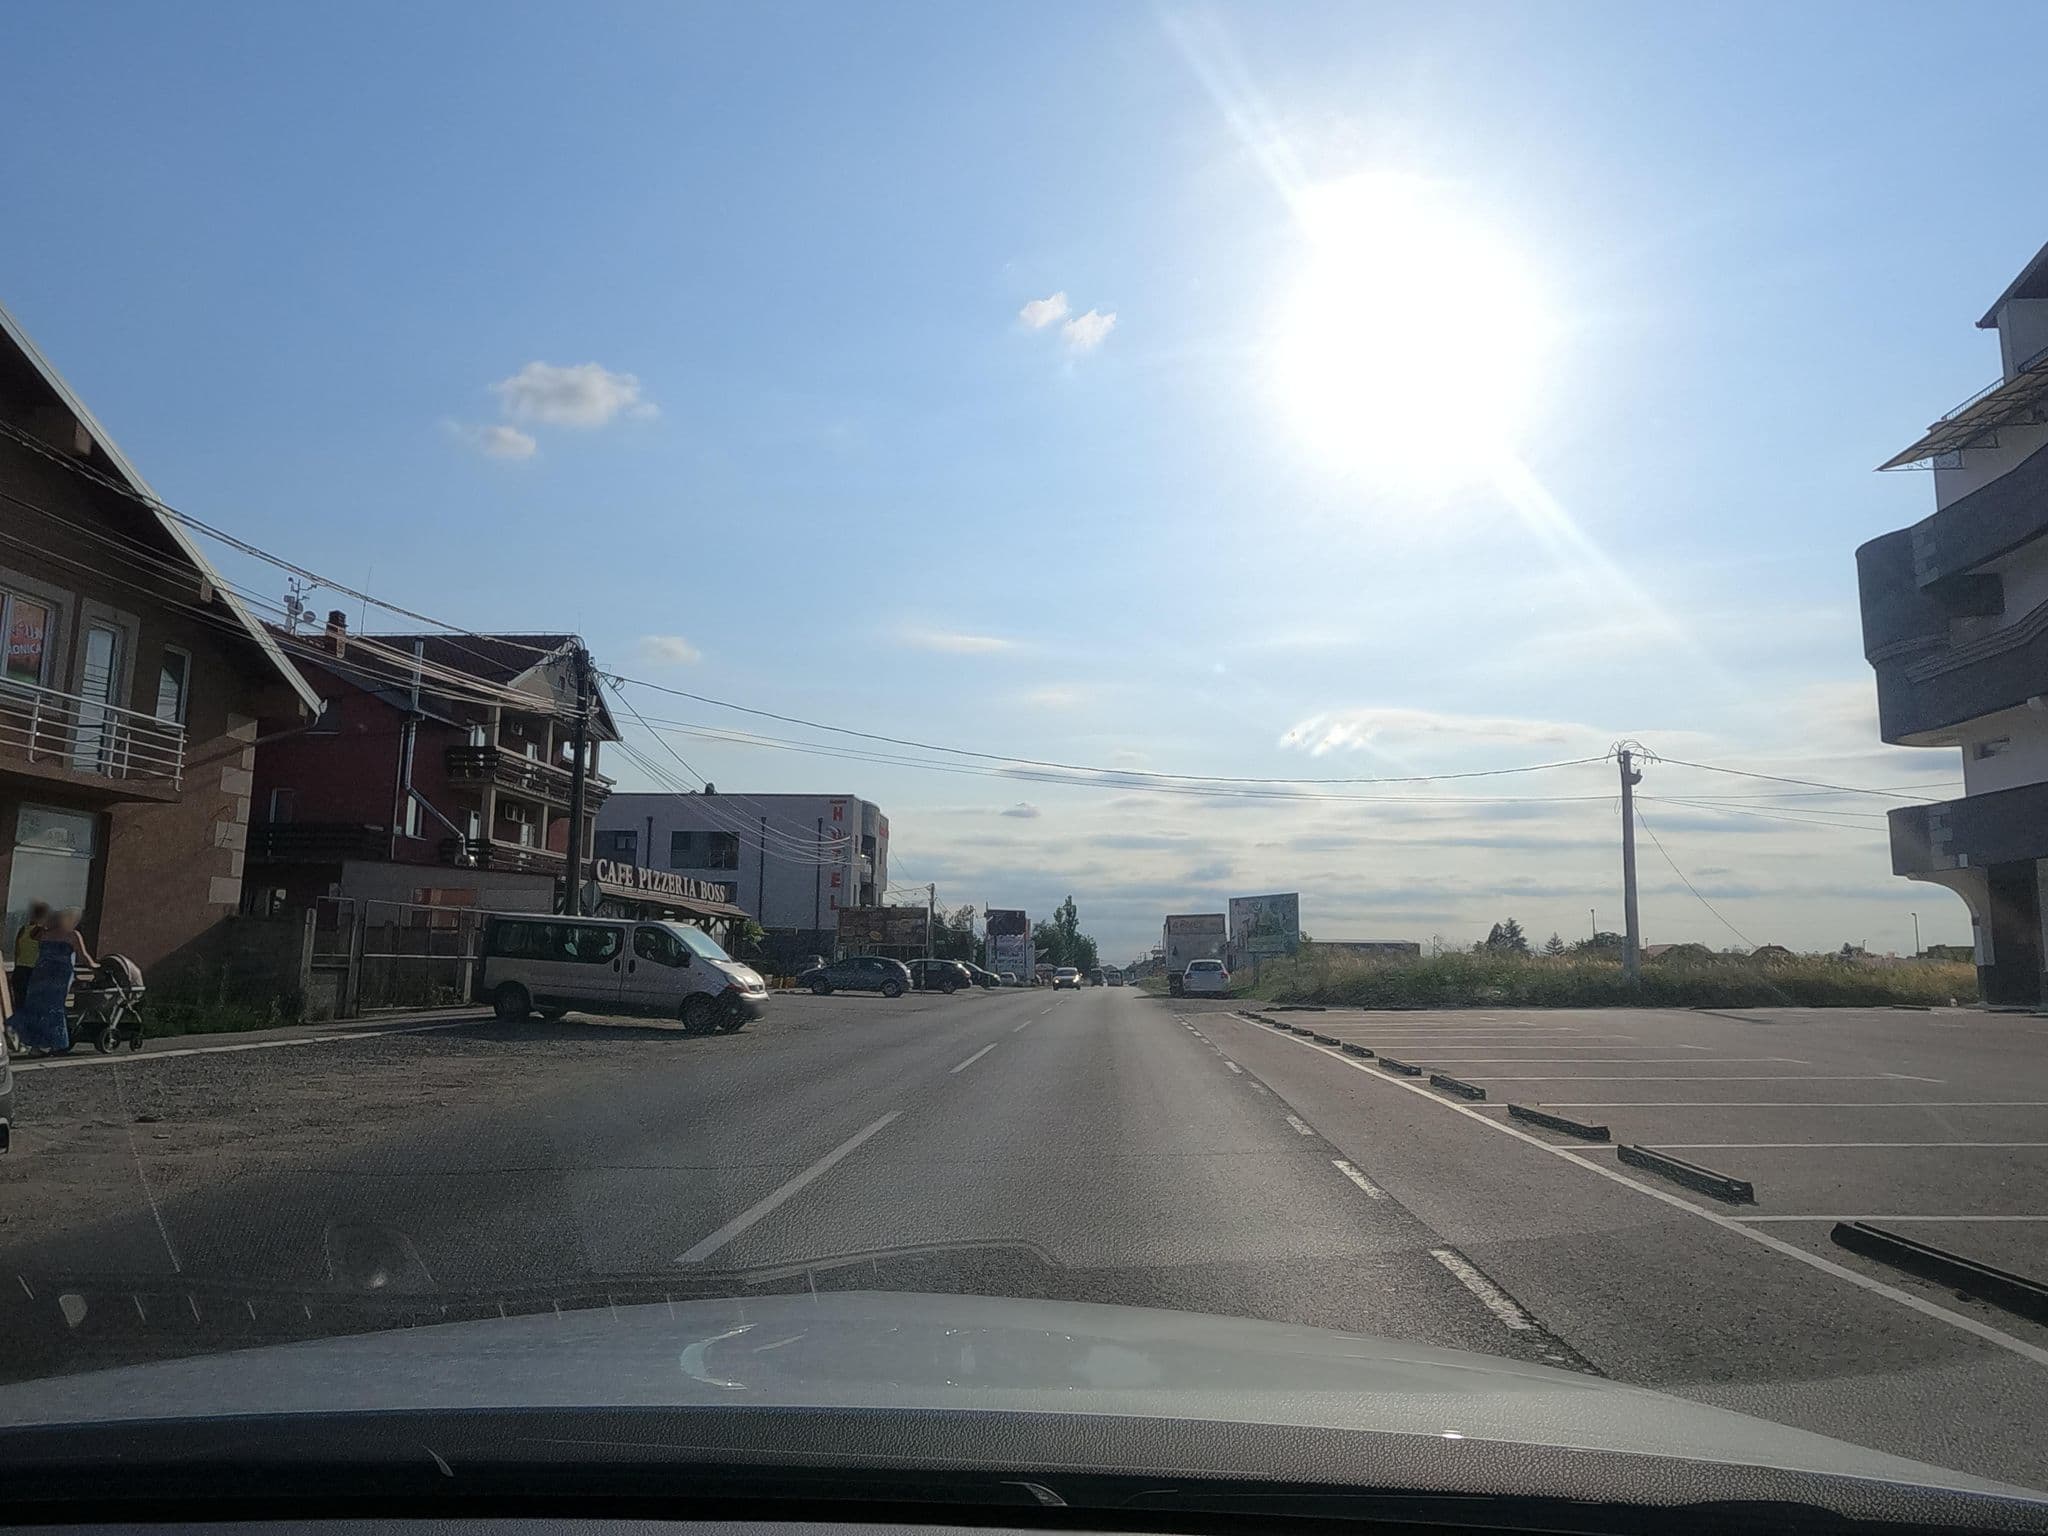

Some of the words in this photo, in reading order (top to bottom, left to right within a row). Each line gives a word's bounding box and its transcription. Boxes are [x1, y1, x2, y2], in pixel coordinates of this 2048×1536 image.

[597, 859, 634, 887] CAFE
[638, 867, 696, 898] PIZZERIA
[700, 881, 726, 903] BOSS
